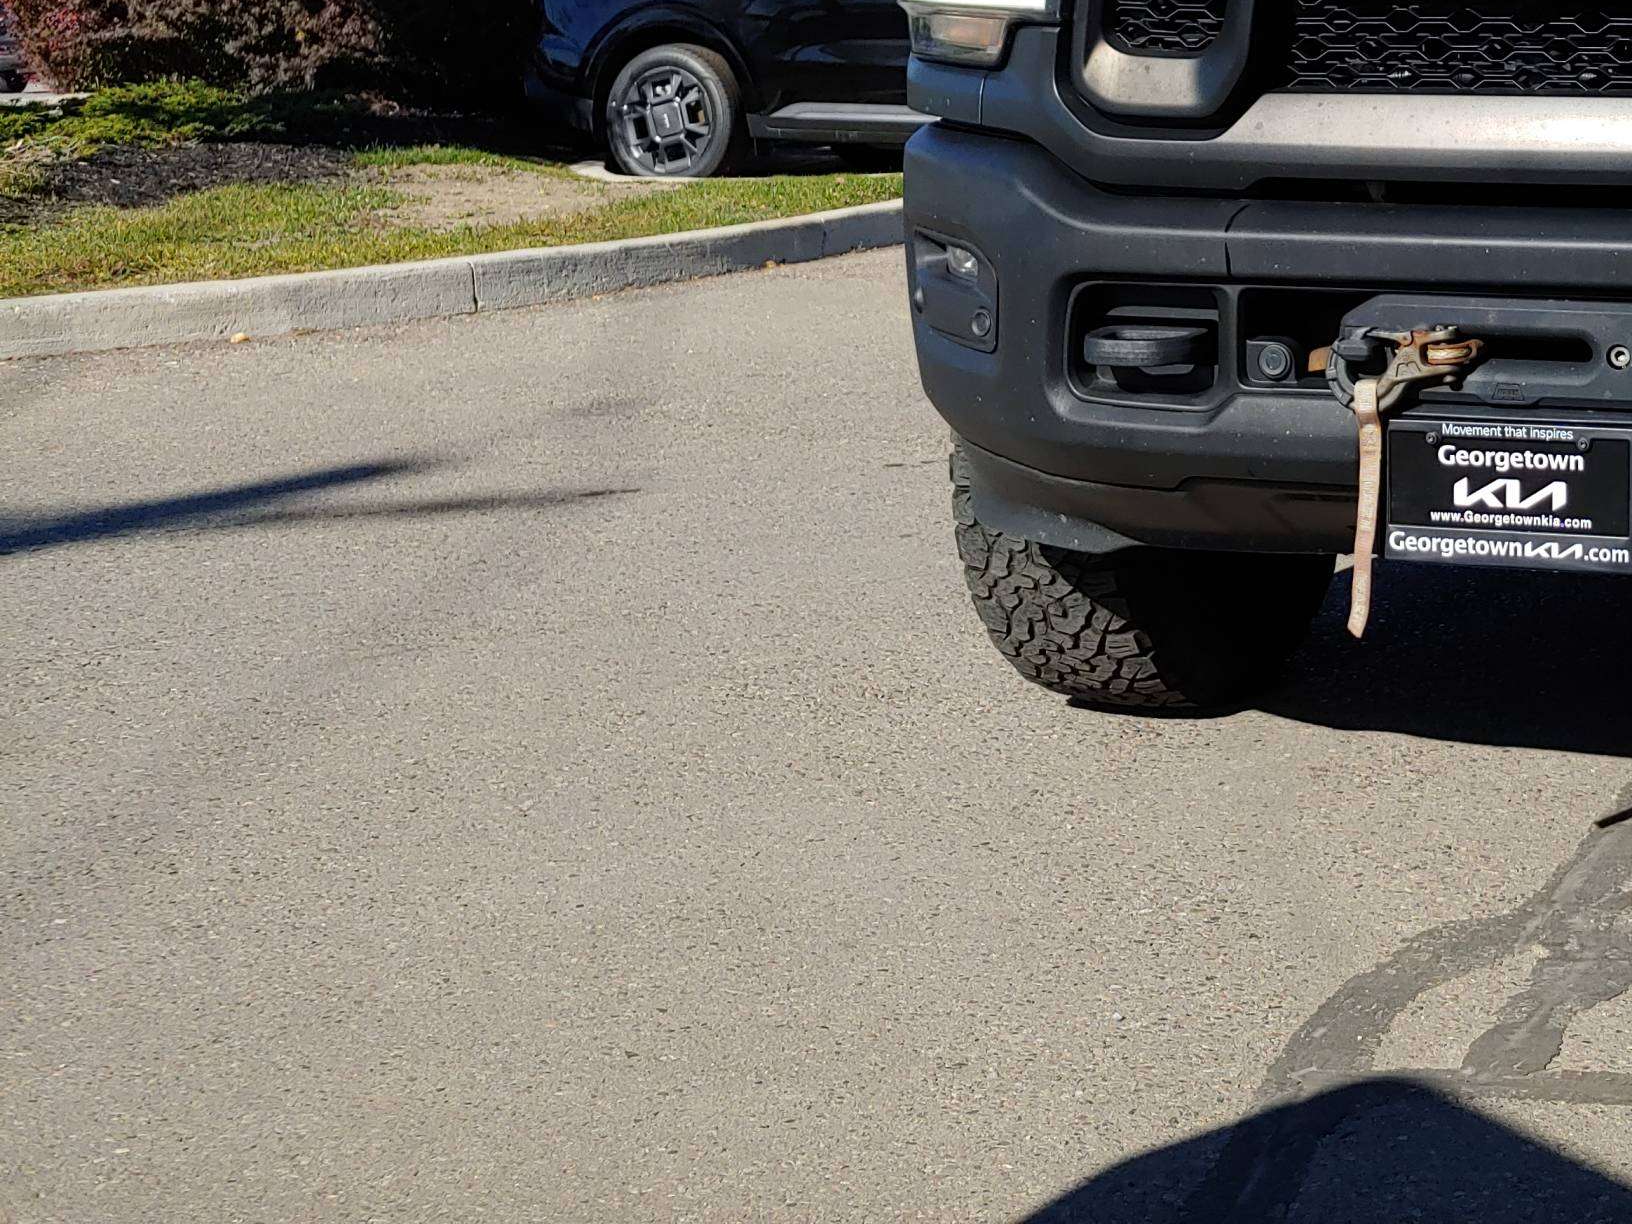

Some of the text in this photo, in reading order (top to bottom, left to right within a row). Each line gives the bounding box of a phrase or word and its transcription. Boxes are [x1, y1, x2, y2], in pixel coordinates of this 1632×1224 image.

[1441, 423, 1574, 441] Movement that inspires
[1437, 444, 1585, 472] Georgetown
[1453, 476, 1567, 512] KIA
[1430, 510, 1593, 529] www.Georgetownkia.com
